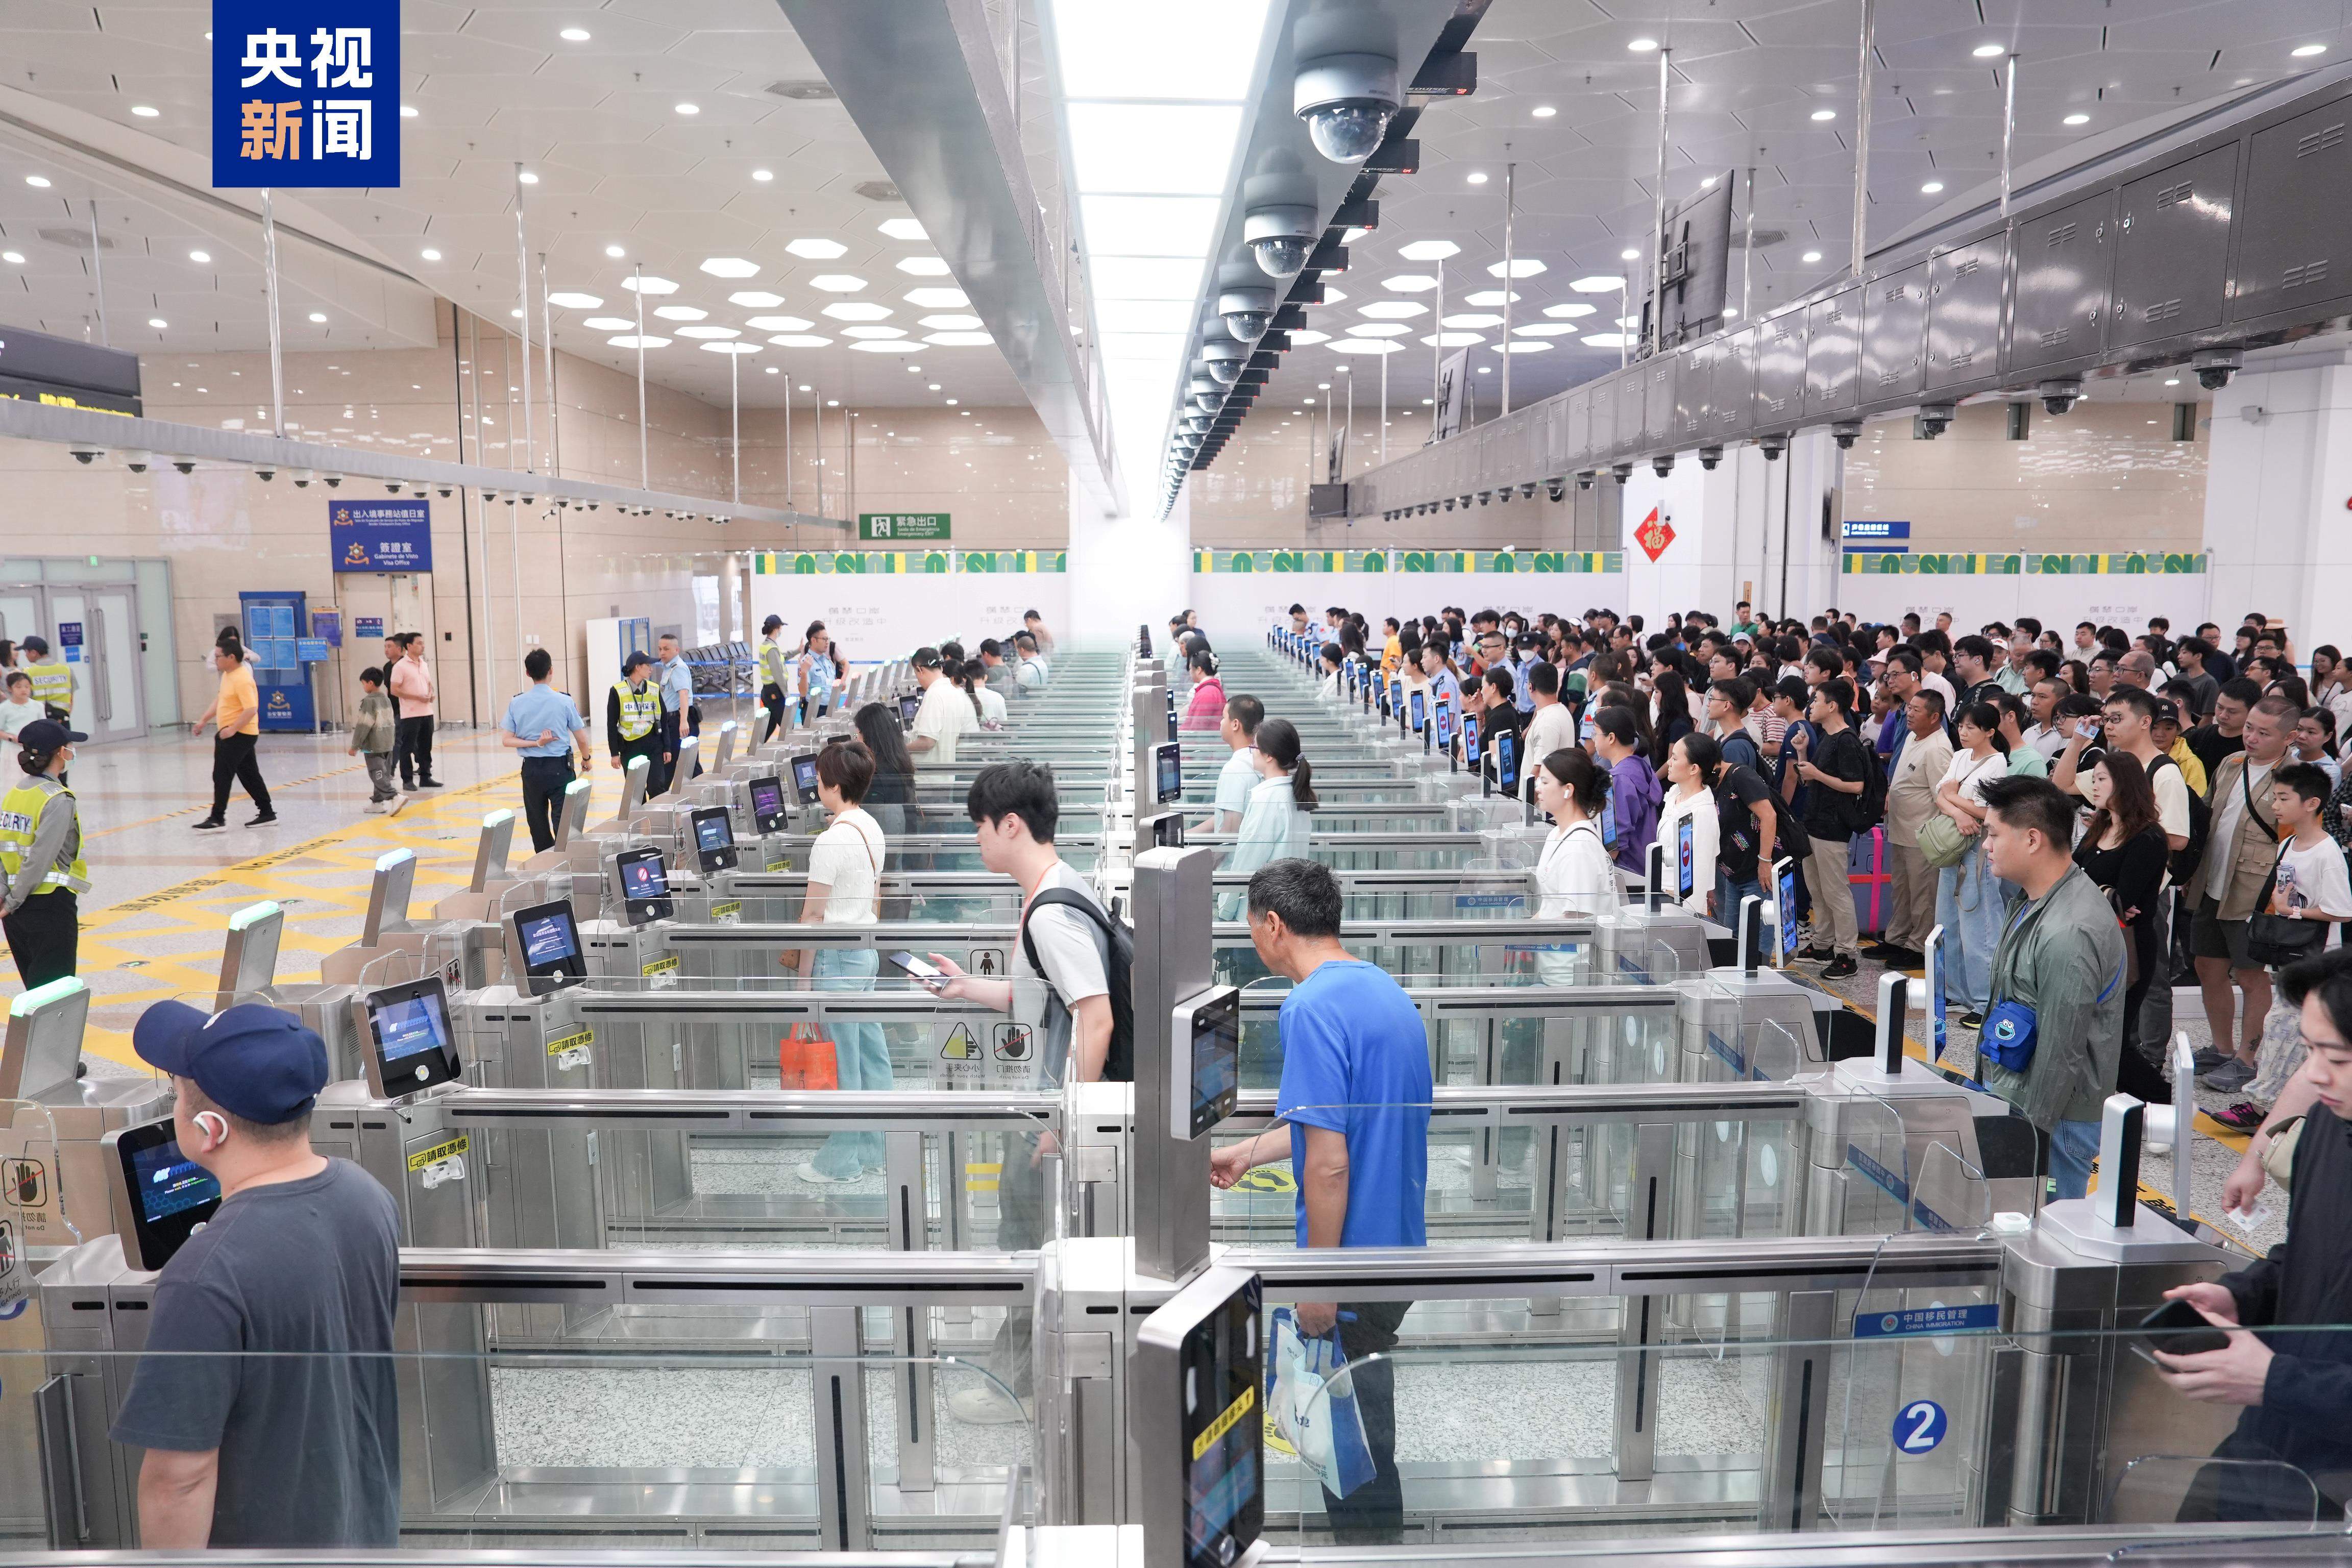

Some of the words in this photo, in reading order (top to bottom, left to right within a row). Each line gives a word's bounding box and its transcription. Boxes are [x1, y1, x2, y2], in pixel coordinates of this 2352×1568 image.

[896, 517, 937, 526] 緊急出口
[34, 675, 67, 685] SECURITY
[270, 838, 345, 861] waiting
[653, 958, 678, 972] 請取憑條
[561, 1032, 593, 1050] 請取憑條
[427, 1138, 467, 1163] 請取憑條
[1903, 1309, 1968, 1322] 中国移民管理
[1904, 1403, 1935, 1449] 2
